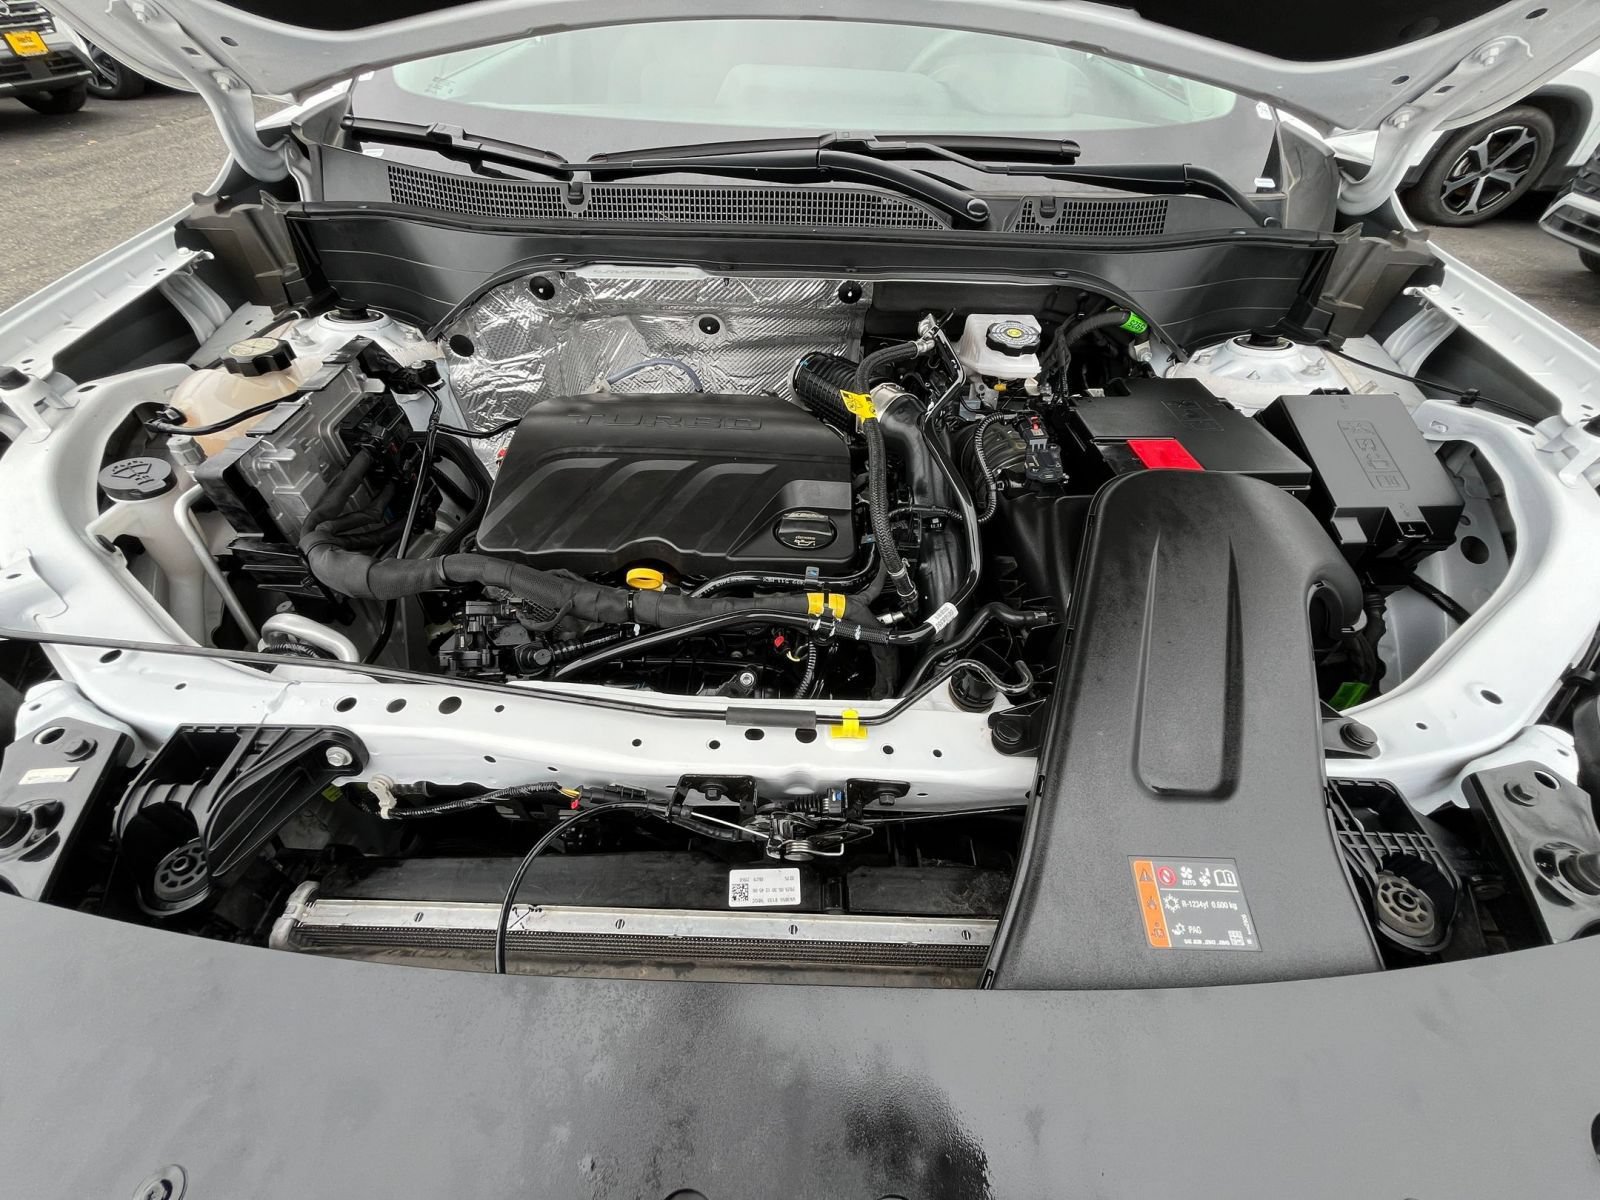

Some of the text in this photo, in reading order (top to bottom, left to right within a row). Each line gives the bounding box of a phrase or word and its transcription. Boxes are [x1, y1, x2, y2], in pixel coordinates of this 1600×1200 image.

[567, 413, 763, 431] TURBO
[1229, 902, 1238, 911] kg
[1188, 926, 1202, 934] PAG
